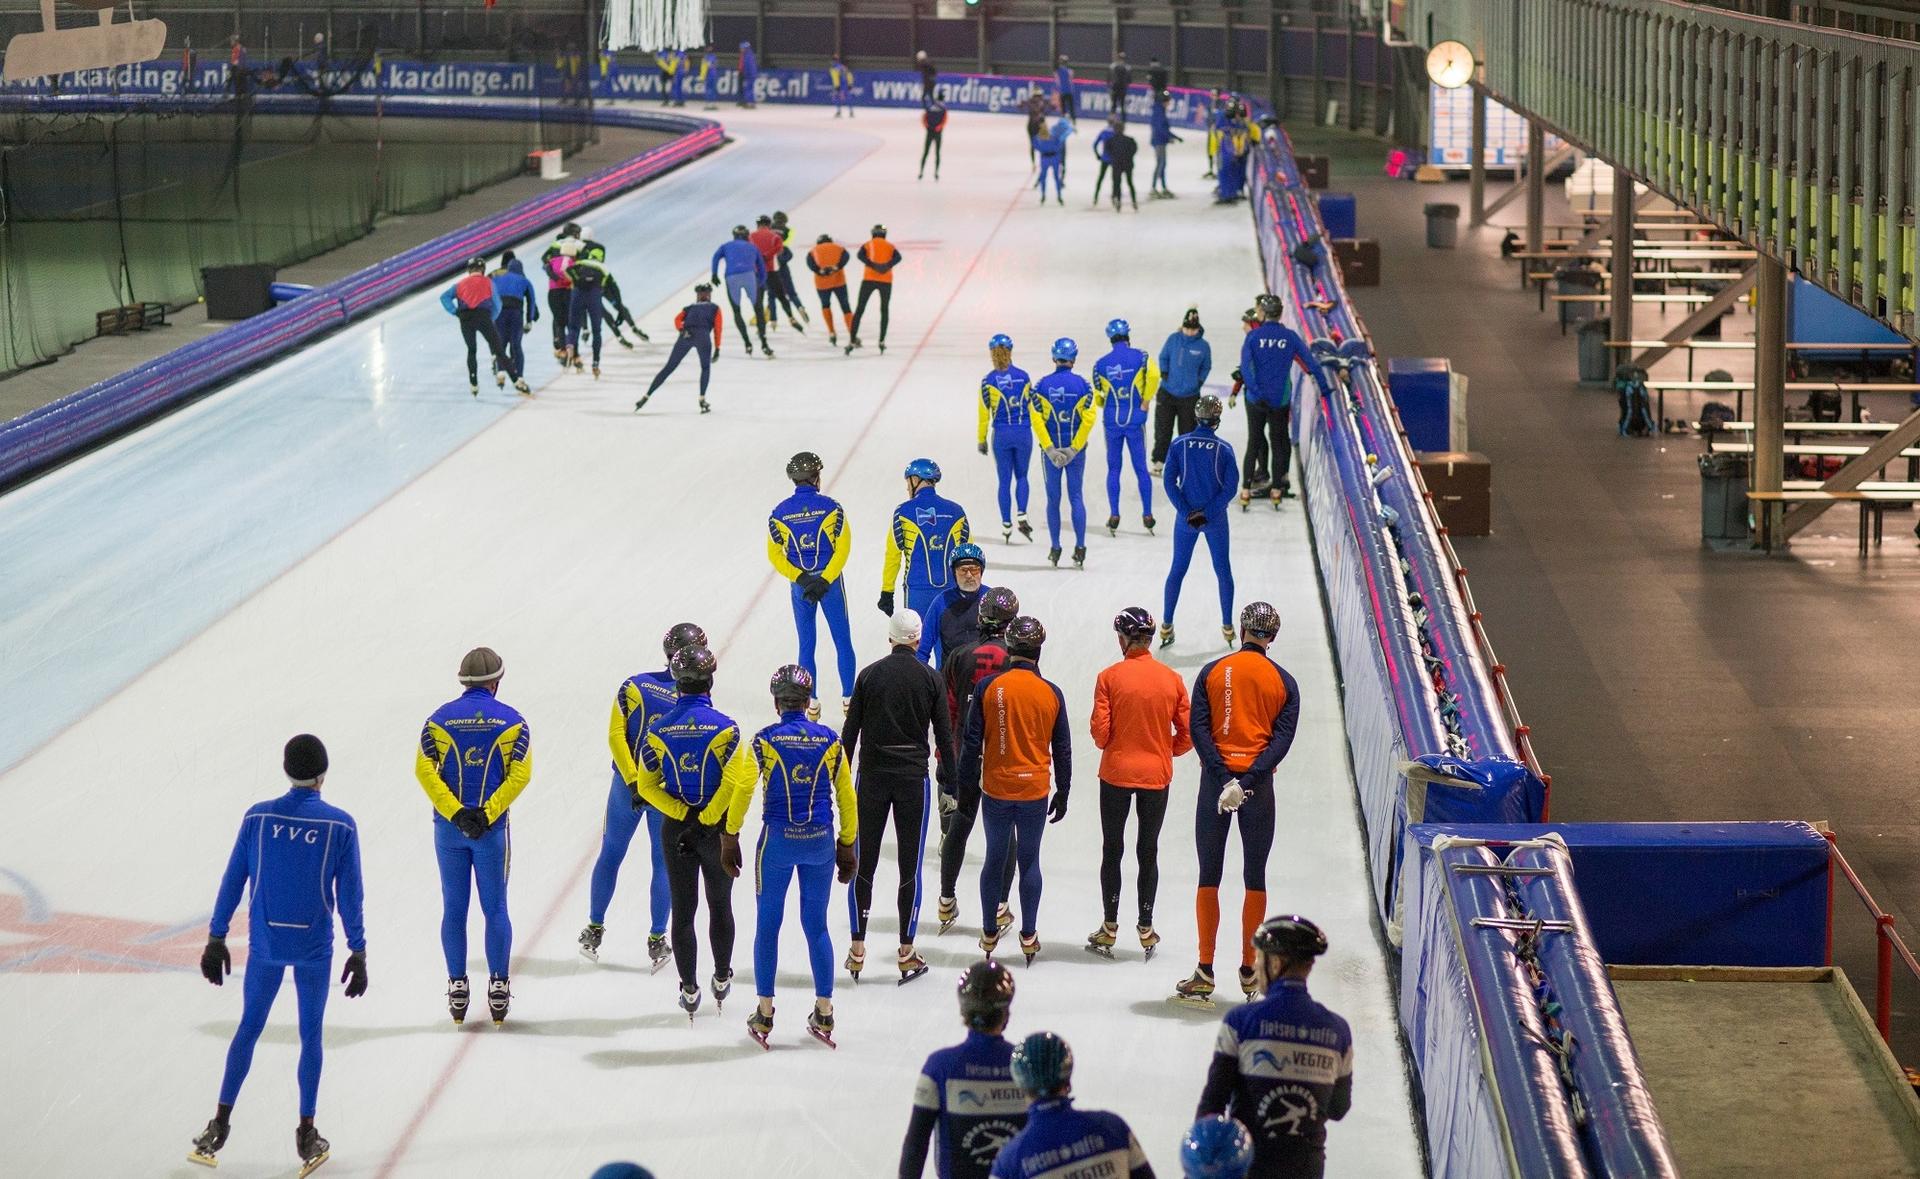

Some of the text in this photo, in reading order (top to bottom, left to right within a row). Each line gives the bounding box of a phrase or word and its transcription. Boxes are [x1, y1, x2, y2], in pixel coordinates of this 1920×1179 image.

[1259, 338, 1287, 349] YVG
[1188, 440, 1215, 450] YVG
[782, 512, 805, 521] COUNTRY
[641, 682, 671, 696] COUNTRY
[444, 718, 507, 727] COUNTRY CAMP
[658, 724, 689, 734] COUNTRY
[771, 735, 802, 743] COUNTRY
[271, 824, 319, 844] YVG
[1292, 1050, 1335, 1070] VEGTER
